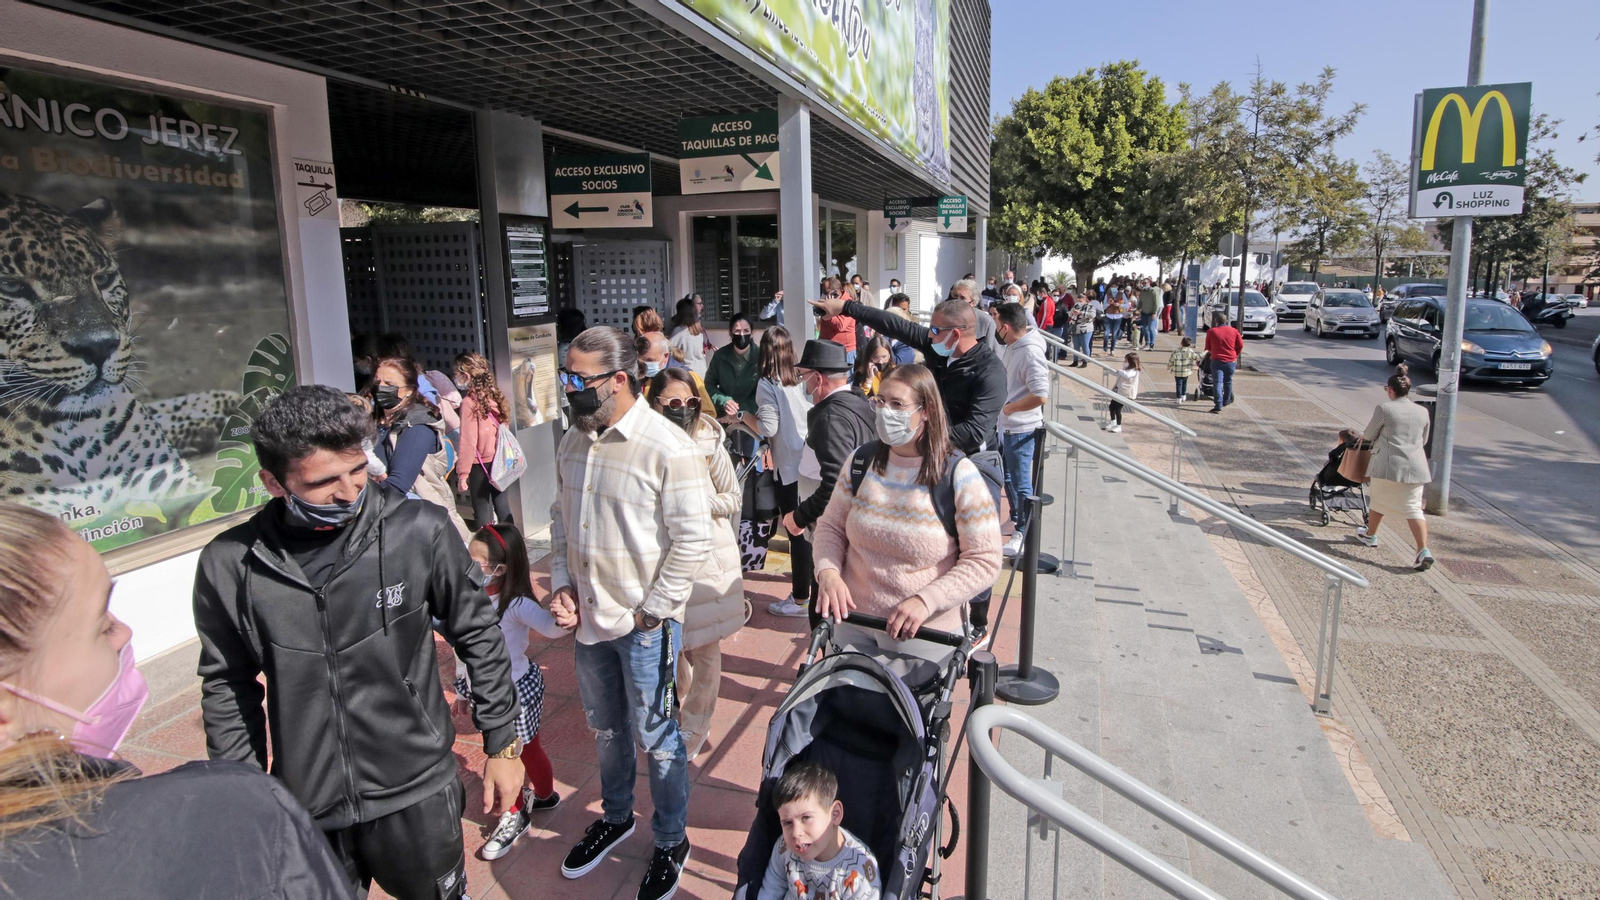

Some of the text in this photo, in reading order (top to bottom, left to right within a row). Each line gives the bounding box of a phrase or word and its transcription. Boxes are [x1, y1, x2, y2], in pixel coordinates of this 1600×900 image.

[711, 120, 752, 133] ACCESO
[142, 114, 242, 156] JEREZ
[682, 138, 736, 151] TAQUILLAS
[738, 136, 752, 147] DE
[32, 147, 244, 189] Biodiversidad
[294, 163, 333, 175] TAQUILLA
[554, 164, 645, 177] ACCESO EXCLUSIVO
[309, 175, 315, 183] 3
[582, 180, 618, 191] SOCIOS
[1473, 191, 1494, 199] LUZ
[1456, 199, 1510, 209] SHOPPING
[60, 505, 101, 521] nka,
